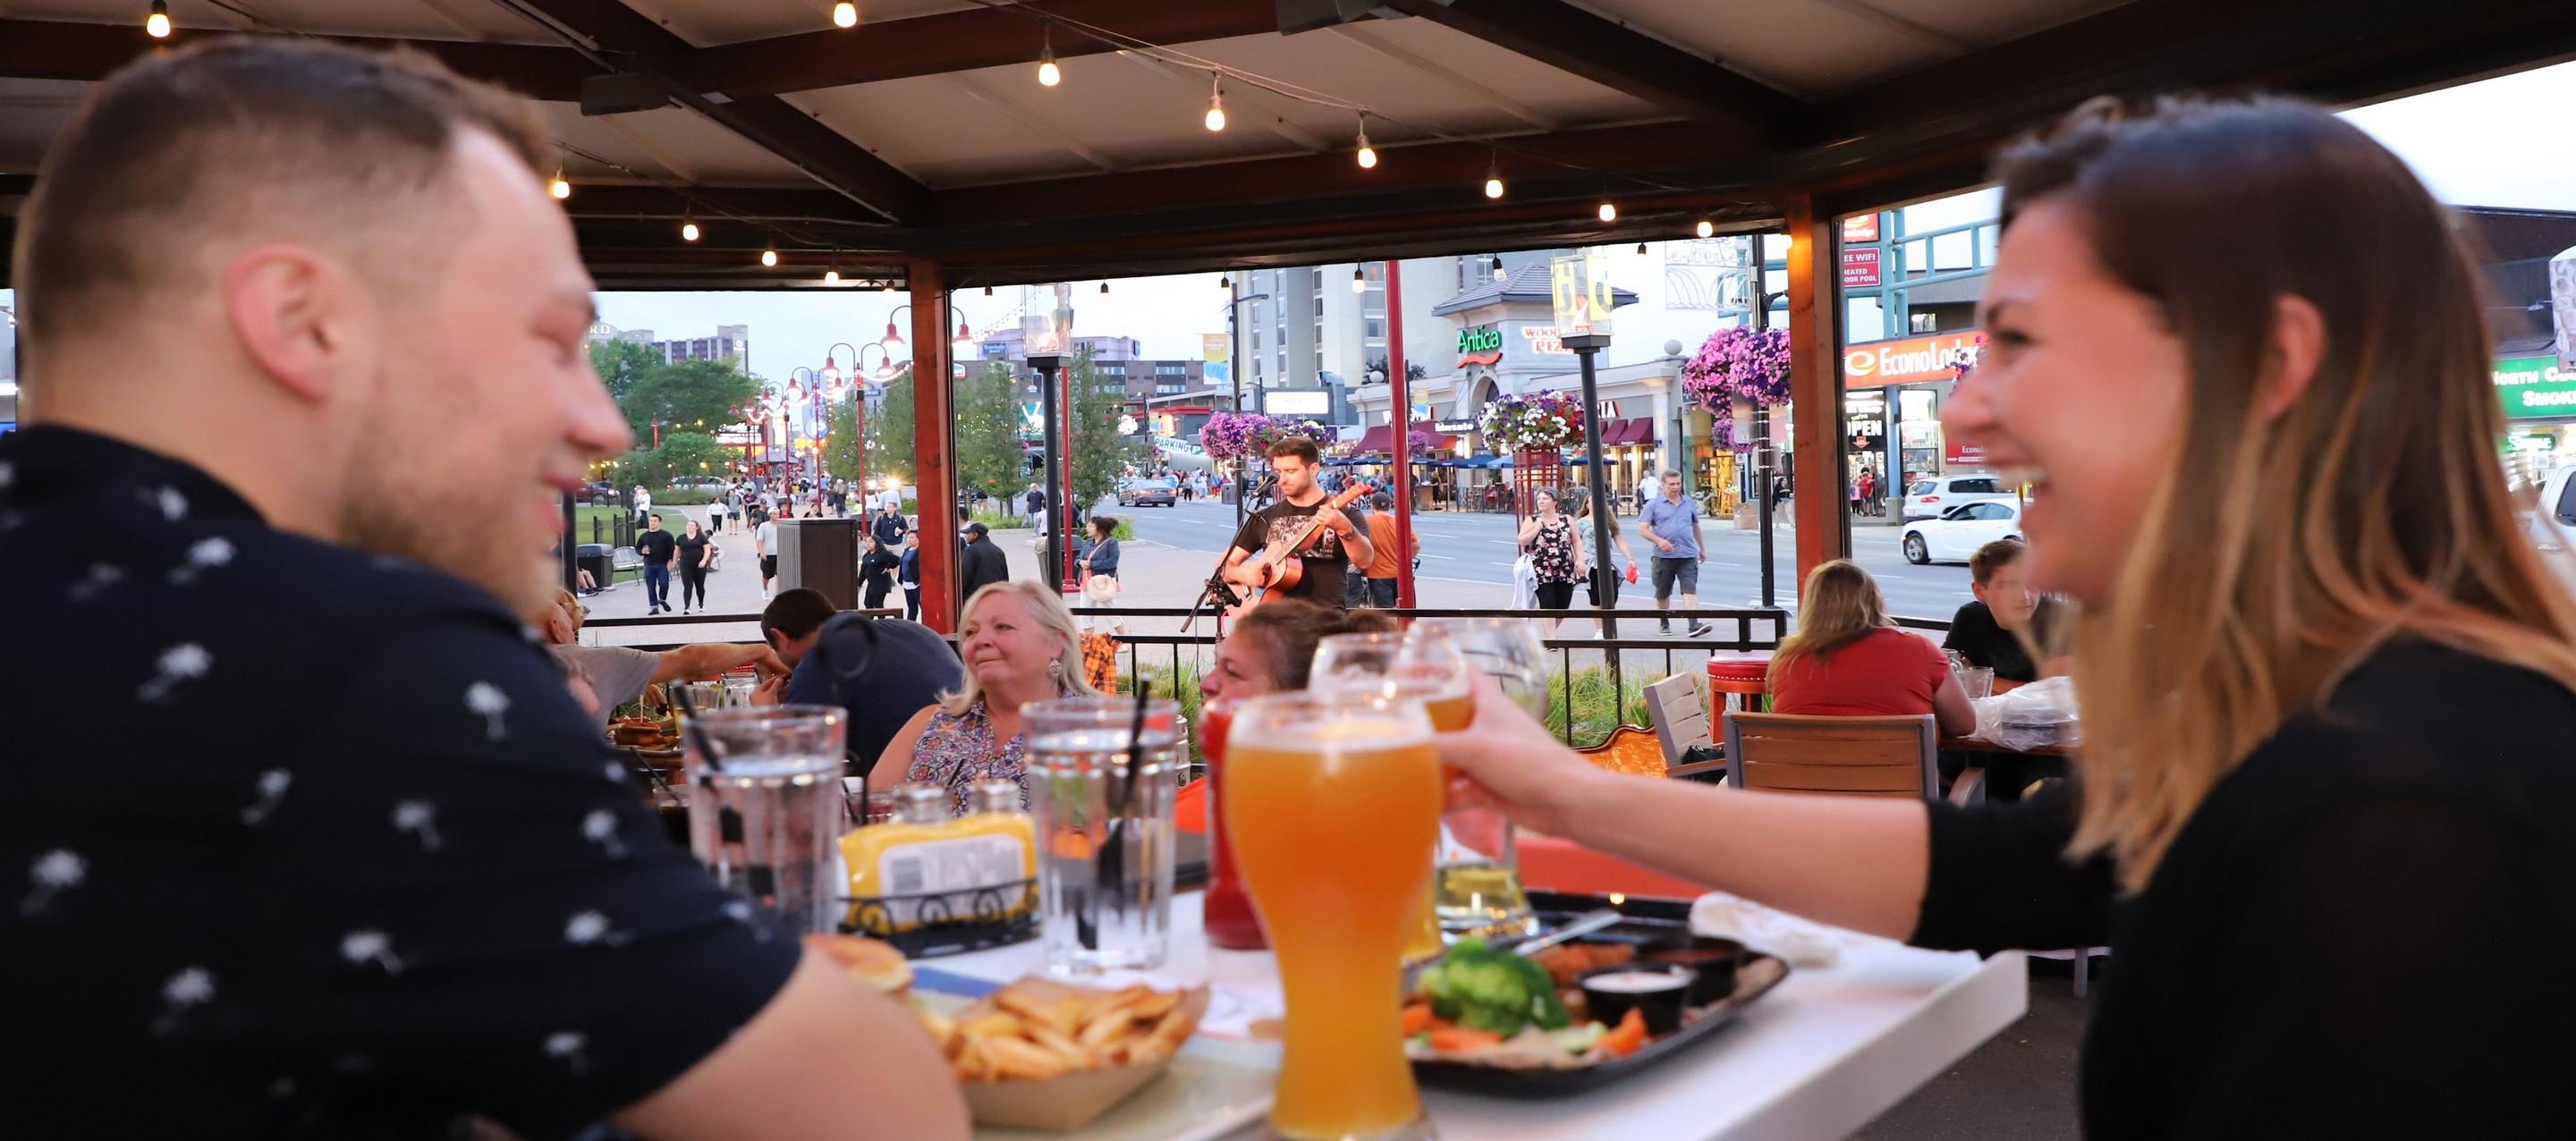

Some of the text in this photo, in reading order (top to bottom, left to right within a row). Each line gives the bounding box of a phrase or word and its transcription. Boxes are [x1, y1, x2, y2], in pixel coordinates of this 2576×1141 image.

[1856, 253, 1876, 261] WIFI
[1457, 325, 1502, 353] Antica
[1535, 341, 1572, 352] PIZ
[2522, 390, 2576, 406] SMOK
[1155, 438, 1189, 452] PARKING
